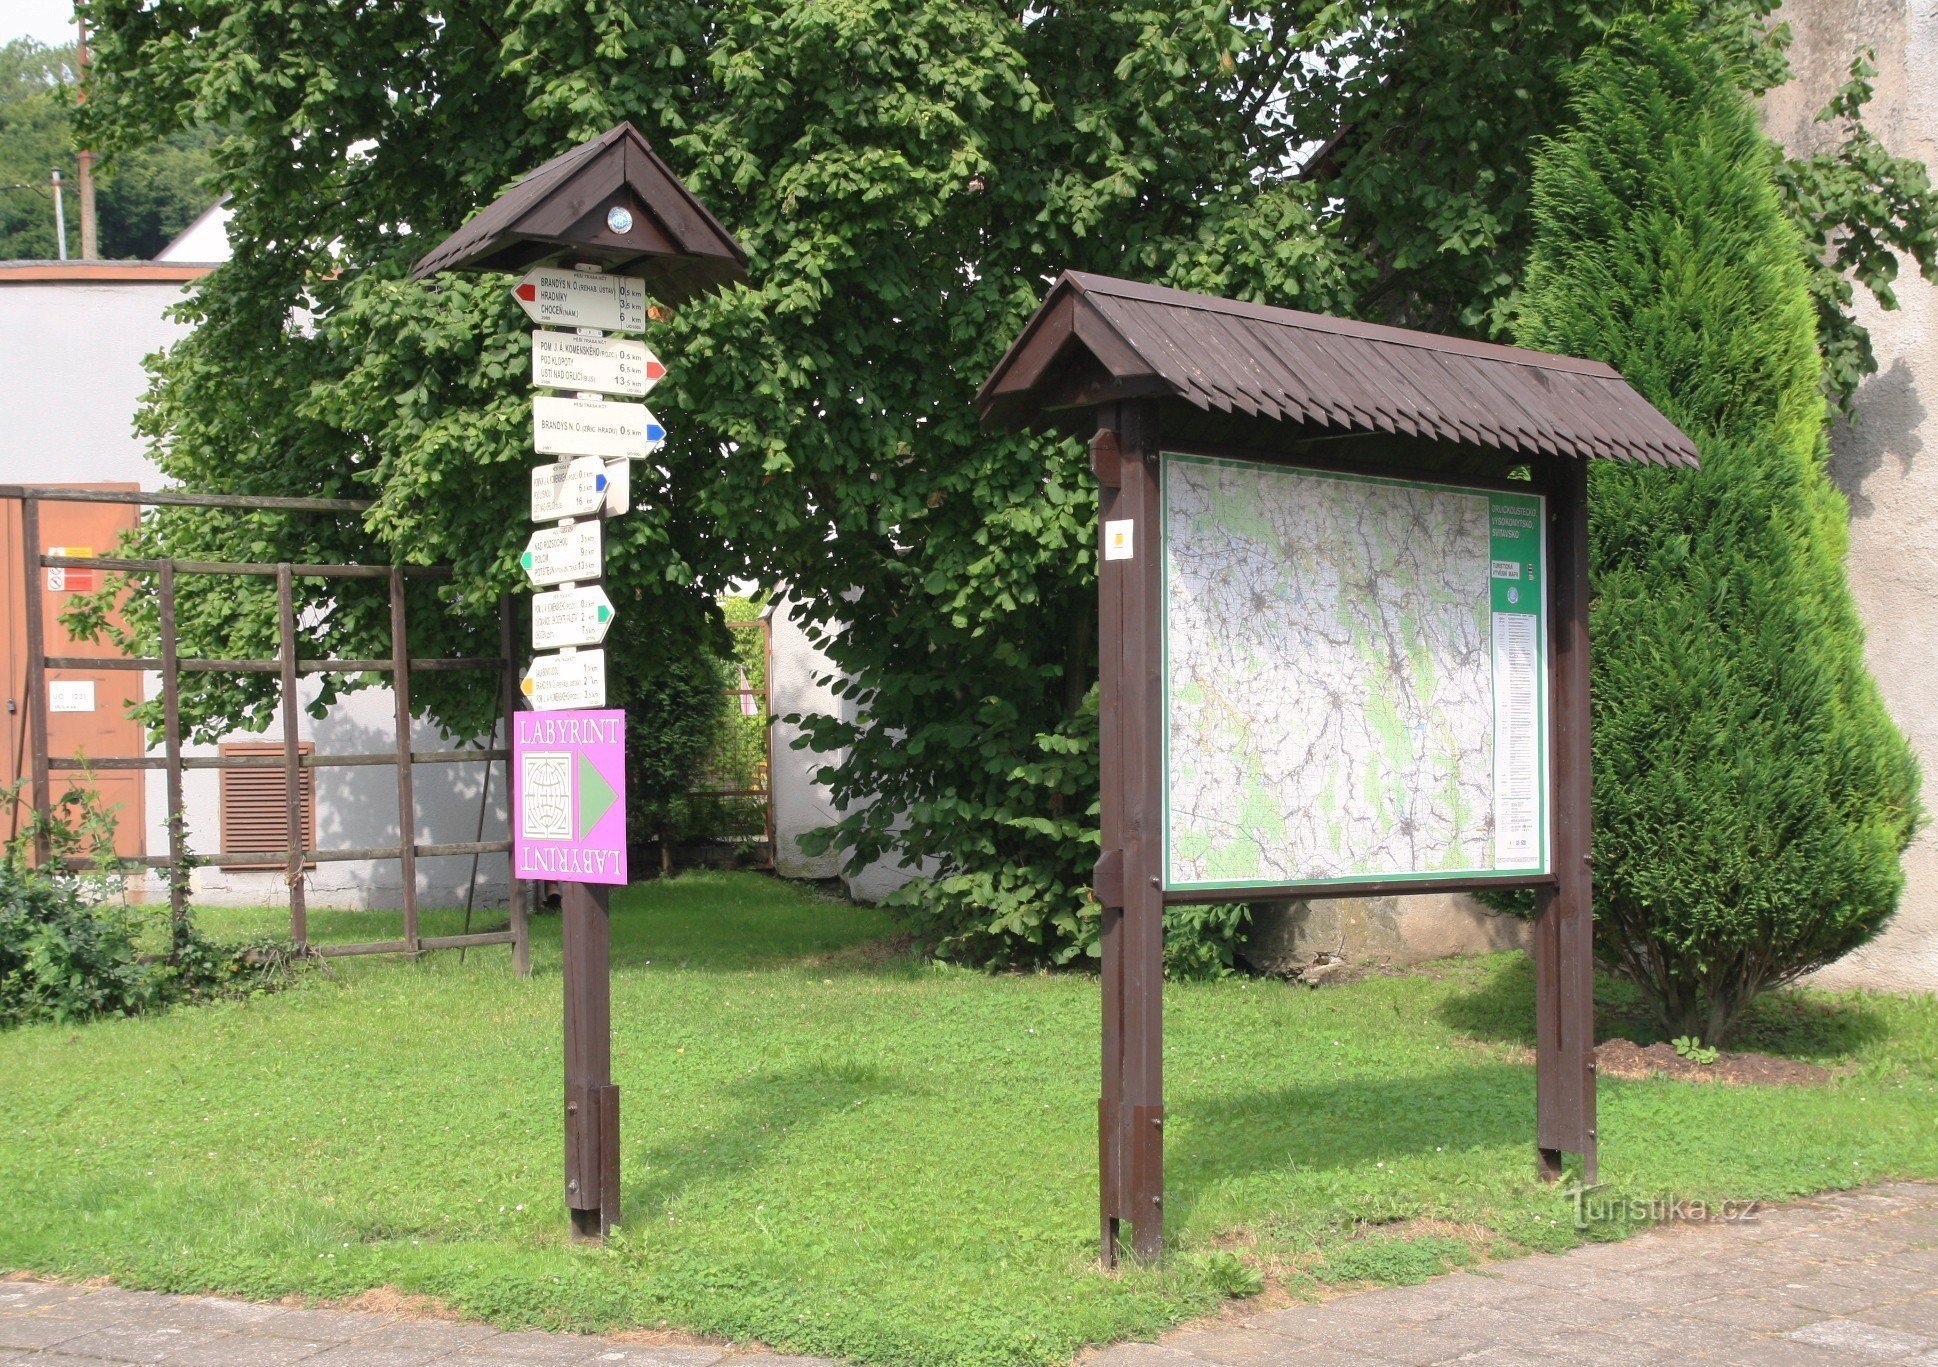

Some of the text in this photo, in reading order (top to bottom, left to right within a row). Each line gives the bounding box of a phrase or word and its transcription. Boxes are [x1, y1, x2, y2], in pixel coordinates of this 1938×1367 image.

[541, 277, 565, 288] BRANDÝS
[567, 280, 572, 290] N.
[541, 291, 567, 302] HRADNÍKY
[620, 313, 625, 321] 6
[566, 344, 599, 356] KOMENSKÉHO
[620, 351, 630, 360] 0,5
[541, 355, 550, 364] POD
[552, 357, 573, 366] KLOPOTY
[620, 364, 630, 373] 6,5
[554, 370, 564, 379] NAD
[615, 376, 630, 385] 13,5
[542, 420, 568, 430] BRANDÝS
[520, 718, 619, 746] LABYRINT
[521, 846, 622, 875] LABYRINT
